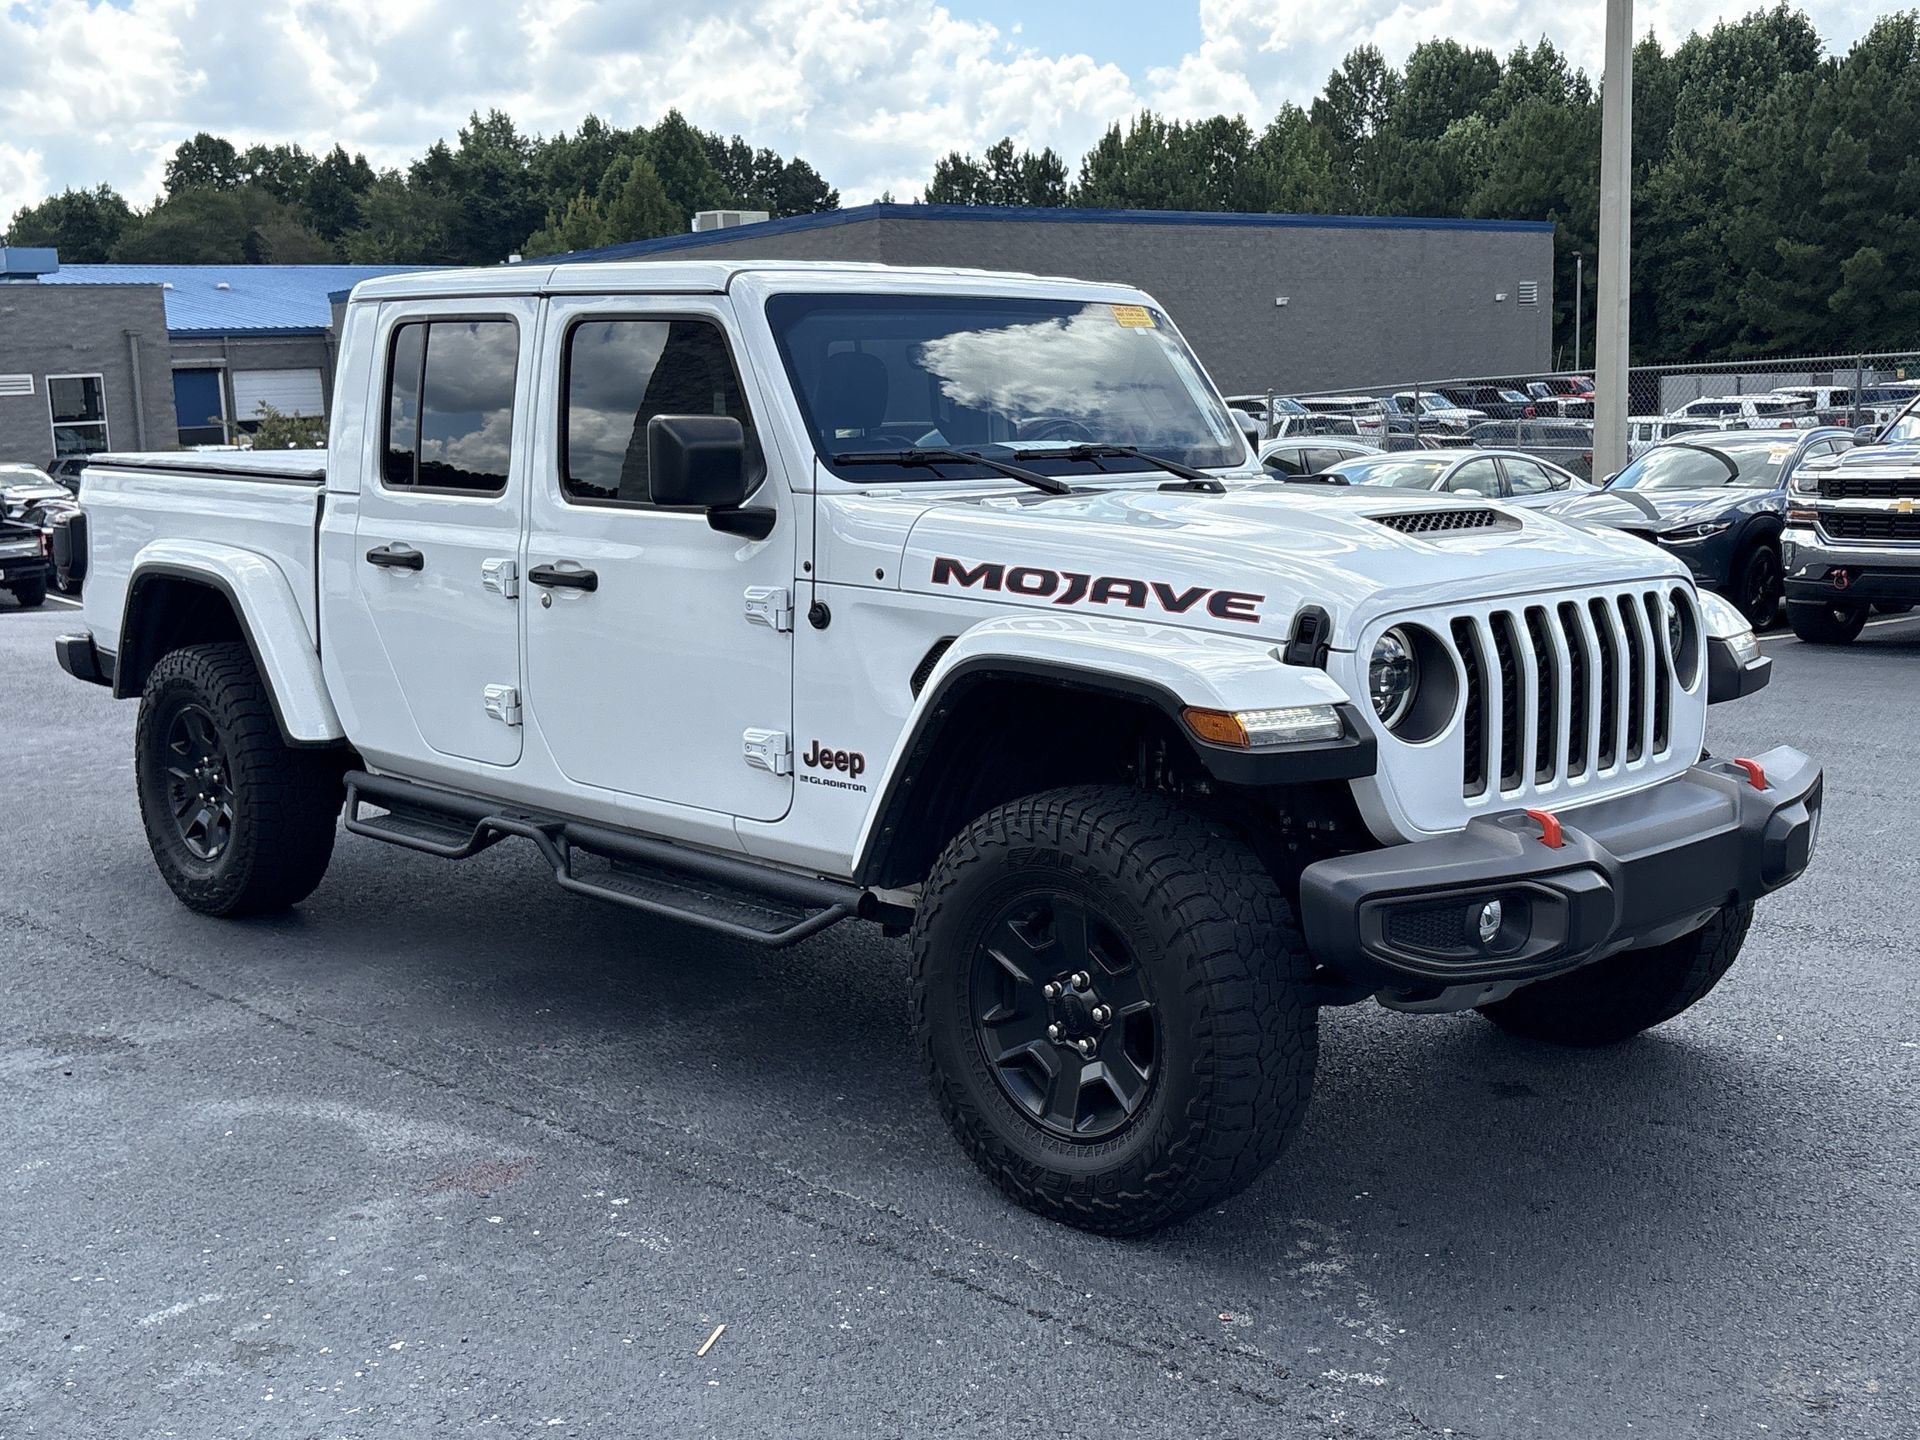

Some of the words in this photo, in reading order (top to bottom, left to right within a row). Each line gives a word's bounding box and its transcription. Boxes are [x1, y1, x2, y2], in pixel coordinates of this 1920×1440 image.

[931, 556, 1265, 623] MOJAVE
[803, 740, 865, 779] Jeep
[809, 775, 867, 793] GLADIATOR
